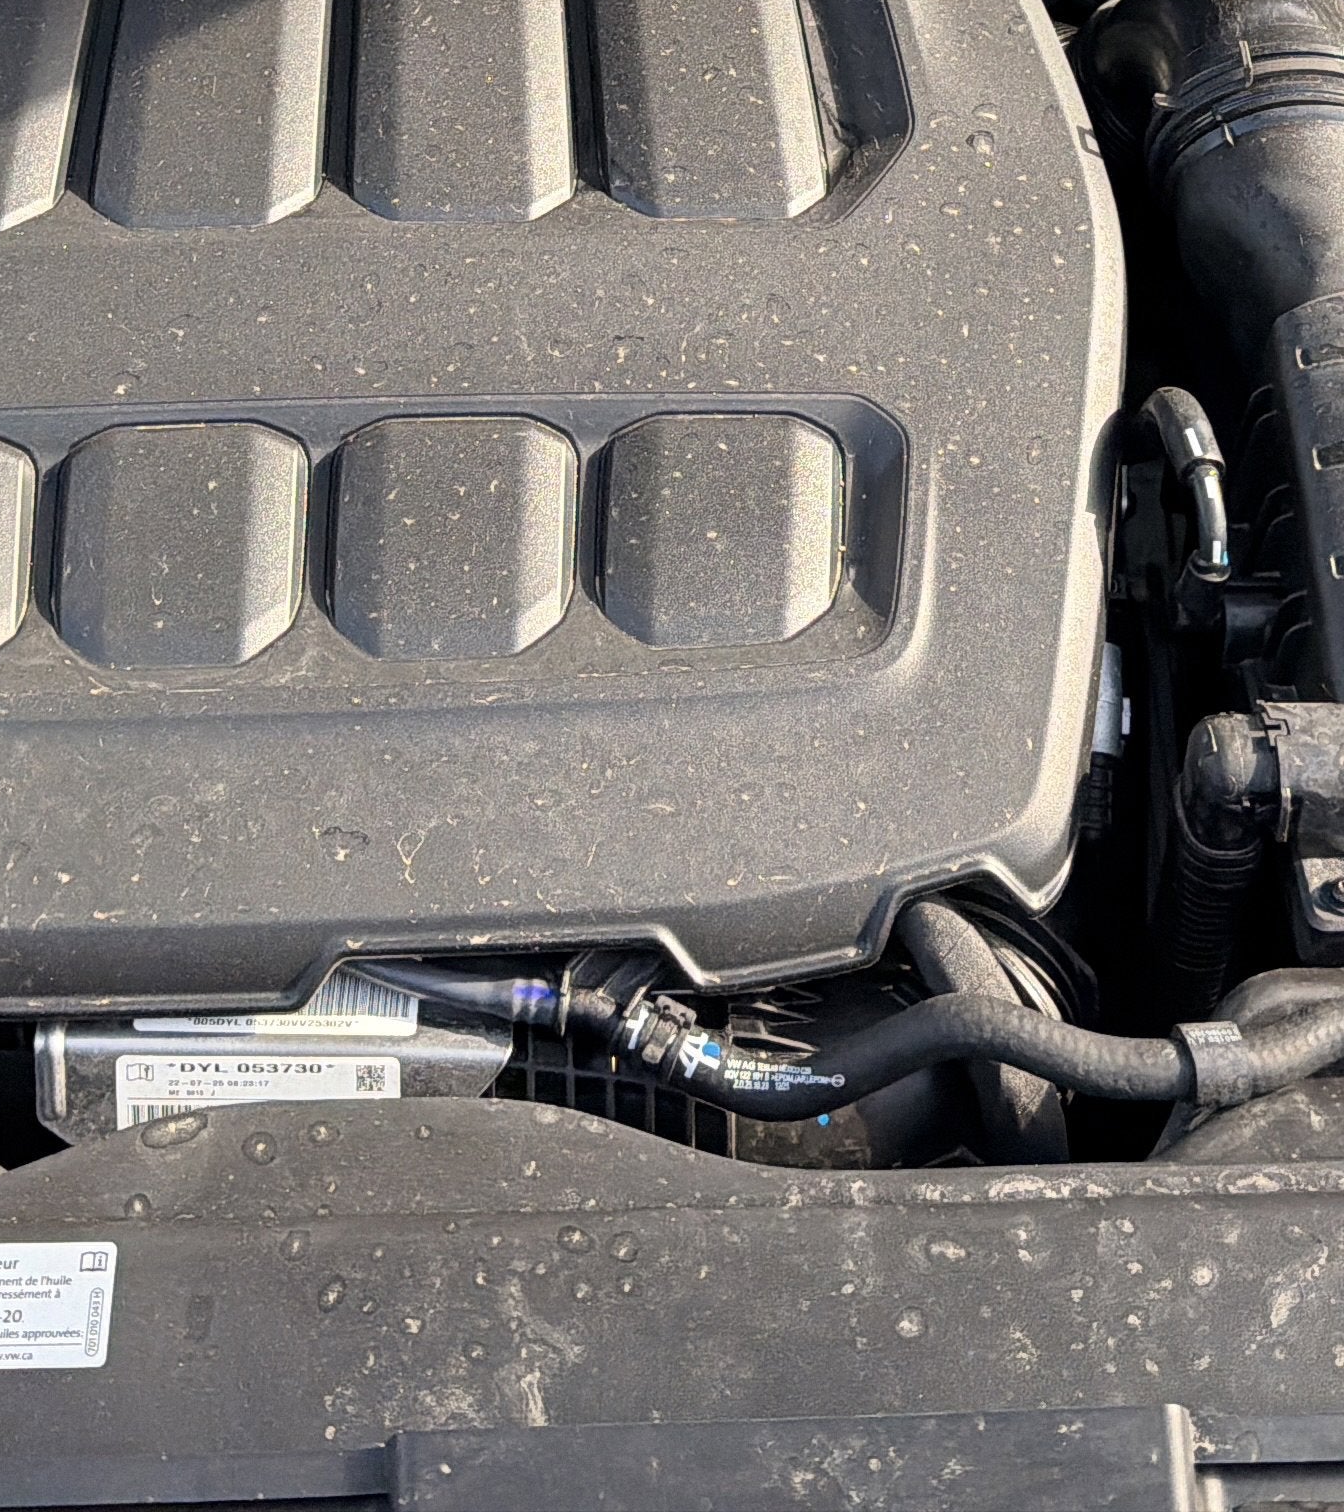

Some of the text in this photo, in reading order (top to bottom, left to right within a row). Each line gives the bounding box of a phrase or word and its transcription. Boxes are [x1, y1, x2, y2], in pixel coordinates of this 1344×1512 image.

[25, 1276, 38, 1286] de
[40, 1275, 72, 1286] l'huile
[54, 1288, 61, 1299] à
[87, 1291, 102, 1353] 701 010 043 H
[21, 1328, 84, 1342] approuvées:
